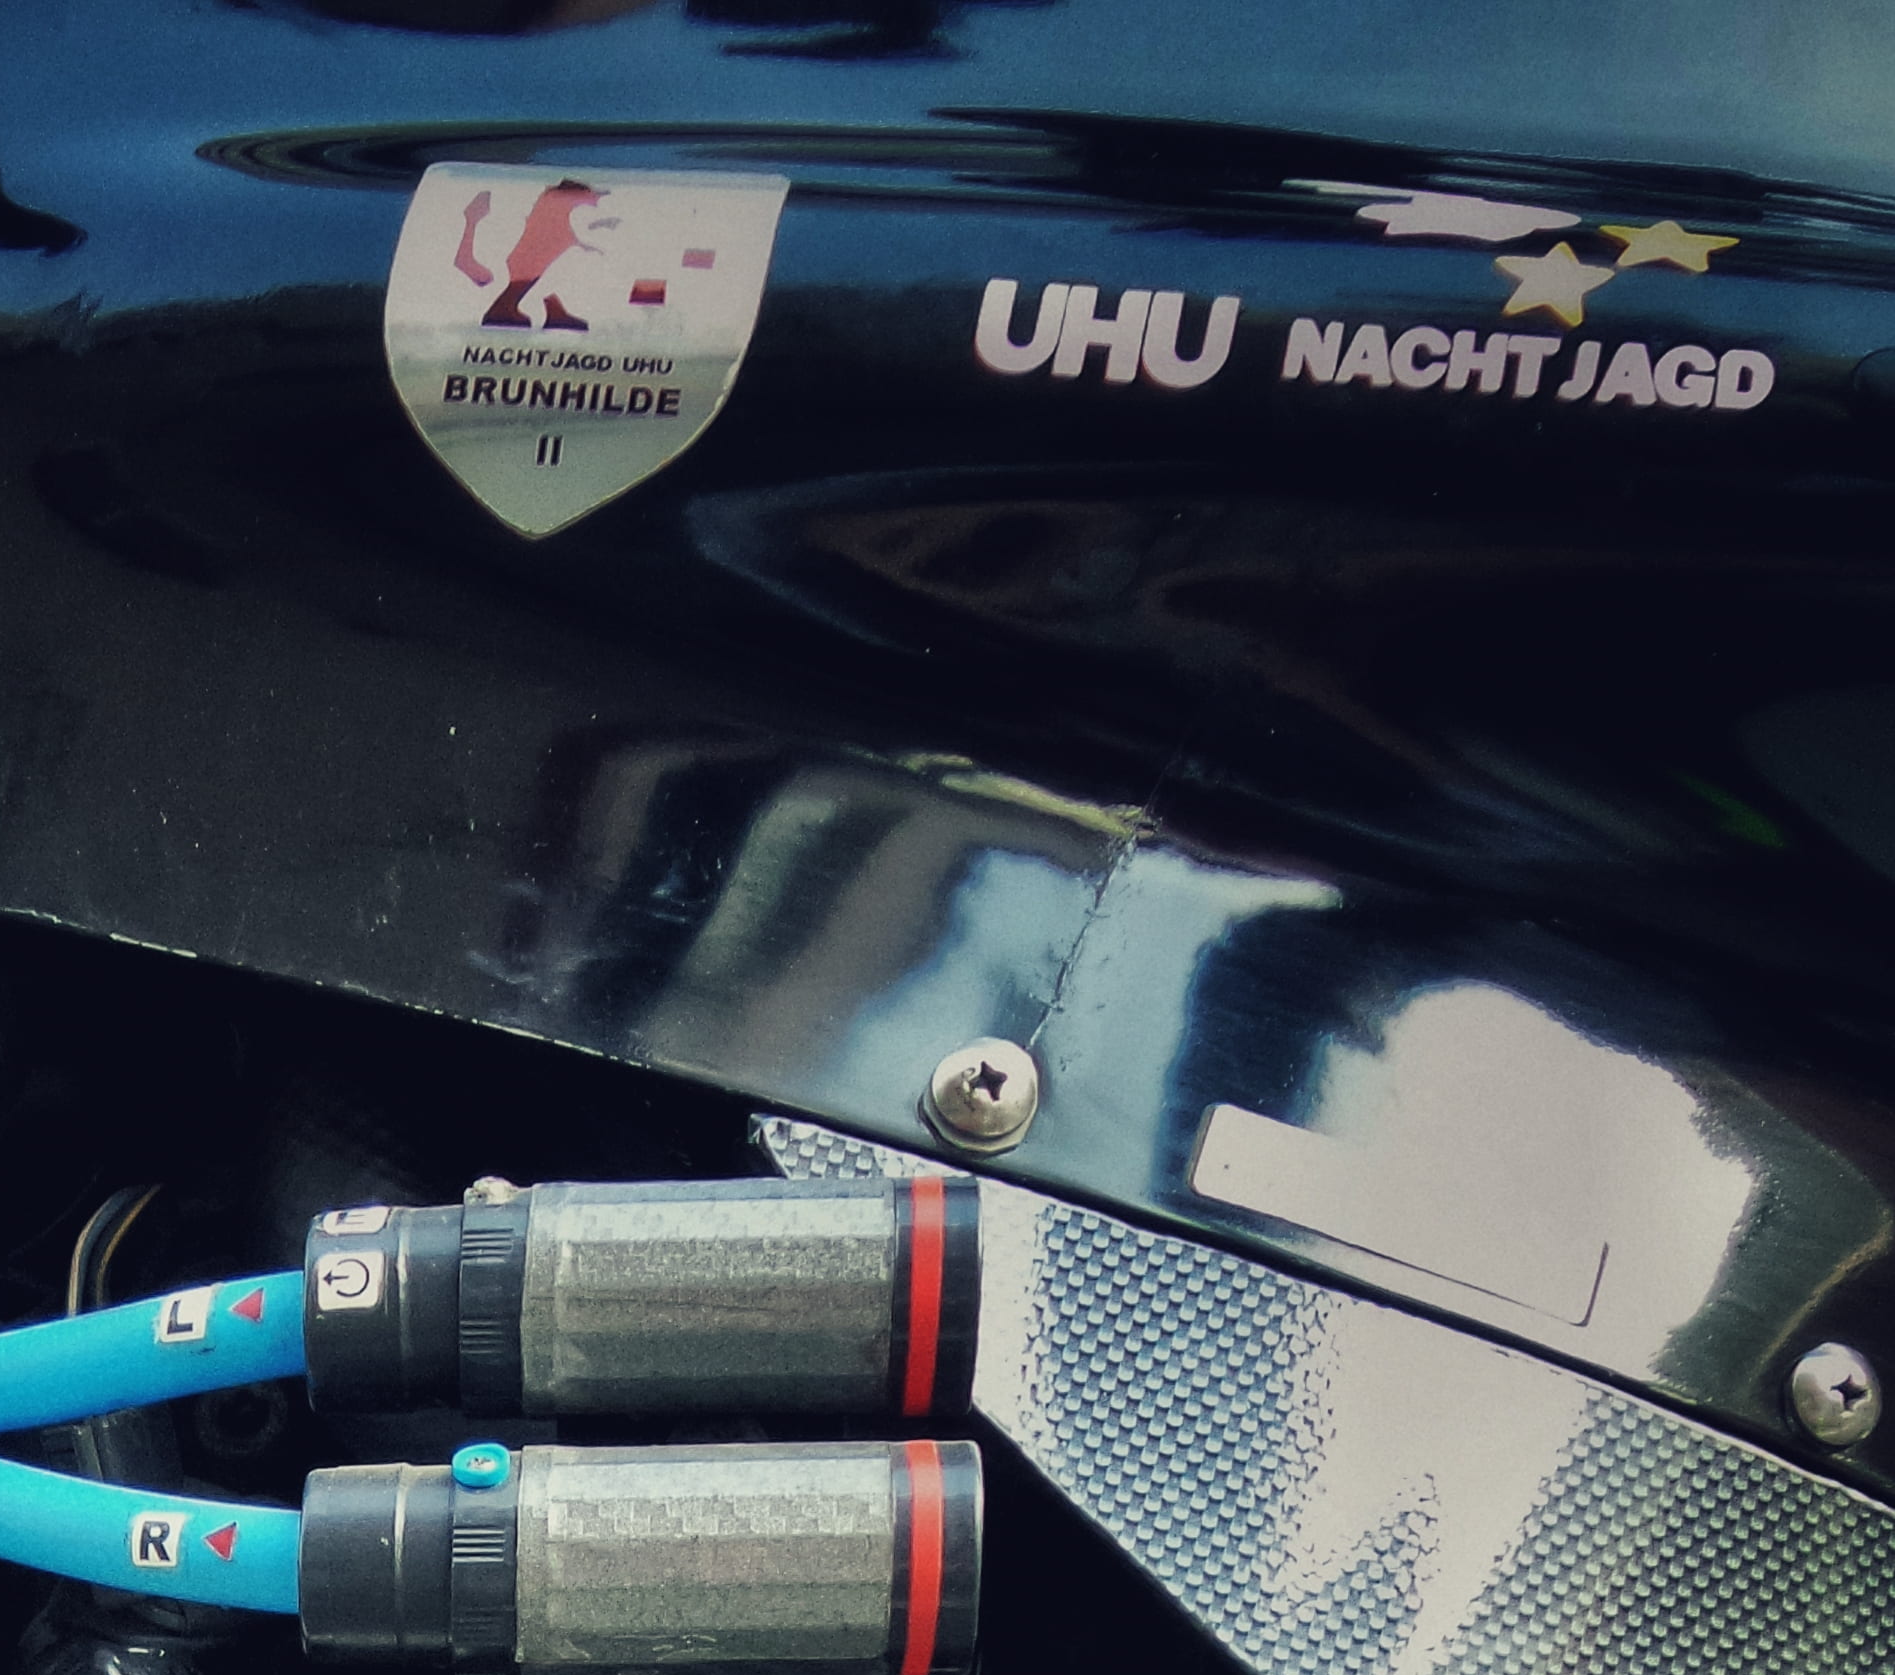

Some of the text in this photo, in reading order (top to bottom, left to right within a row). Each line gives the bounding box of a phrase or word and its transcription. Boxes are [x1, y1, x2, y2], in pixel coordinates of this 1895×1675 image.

[975, 278, 1240, 389] UHU
[622, 356, 674, 375] UHU
[443, 374, 682, 417] BRUNHILDE
[166, 1300, 194, 1336] L
[138, 1521, 171, 1563] R
